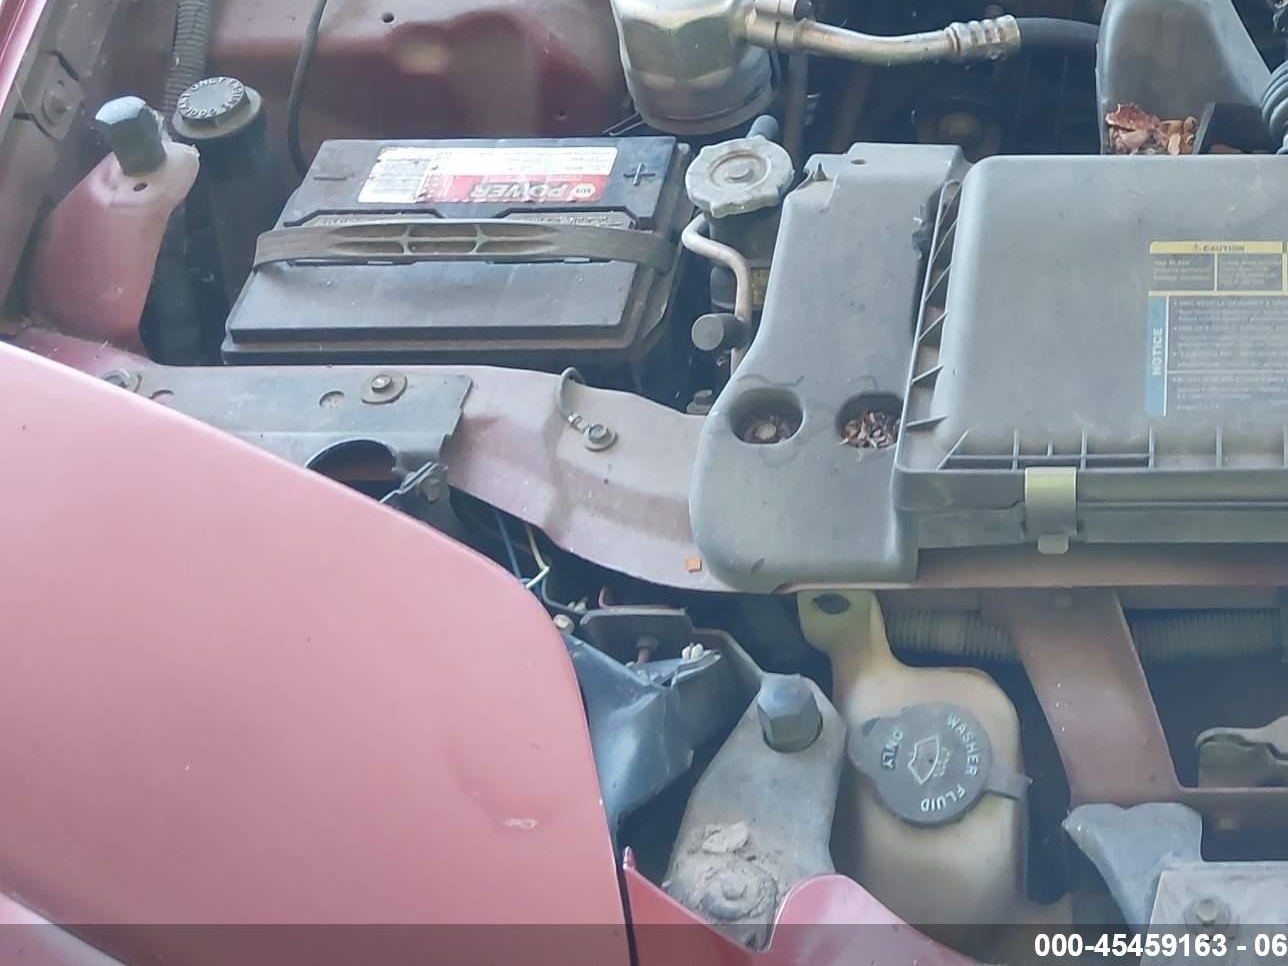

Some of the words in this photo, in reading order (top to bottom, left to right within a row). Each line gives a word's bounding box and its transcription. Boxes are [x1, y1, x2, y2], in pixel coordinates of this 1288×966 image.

[191, 76, 227, 92] ONLY
[470, 182, 568, 199] POWER
[1203, 244, 1245, 252] CAUTION
[1151, 328, 1163, 376] NOTICE
[881, 729, 903, 770] ONLY
[947, 713, 980, 777] WASHER
[920, 783, 966, 812] FLUID
